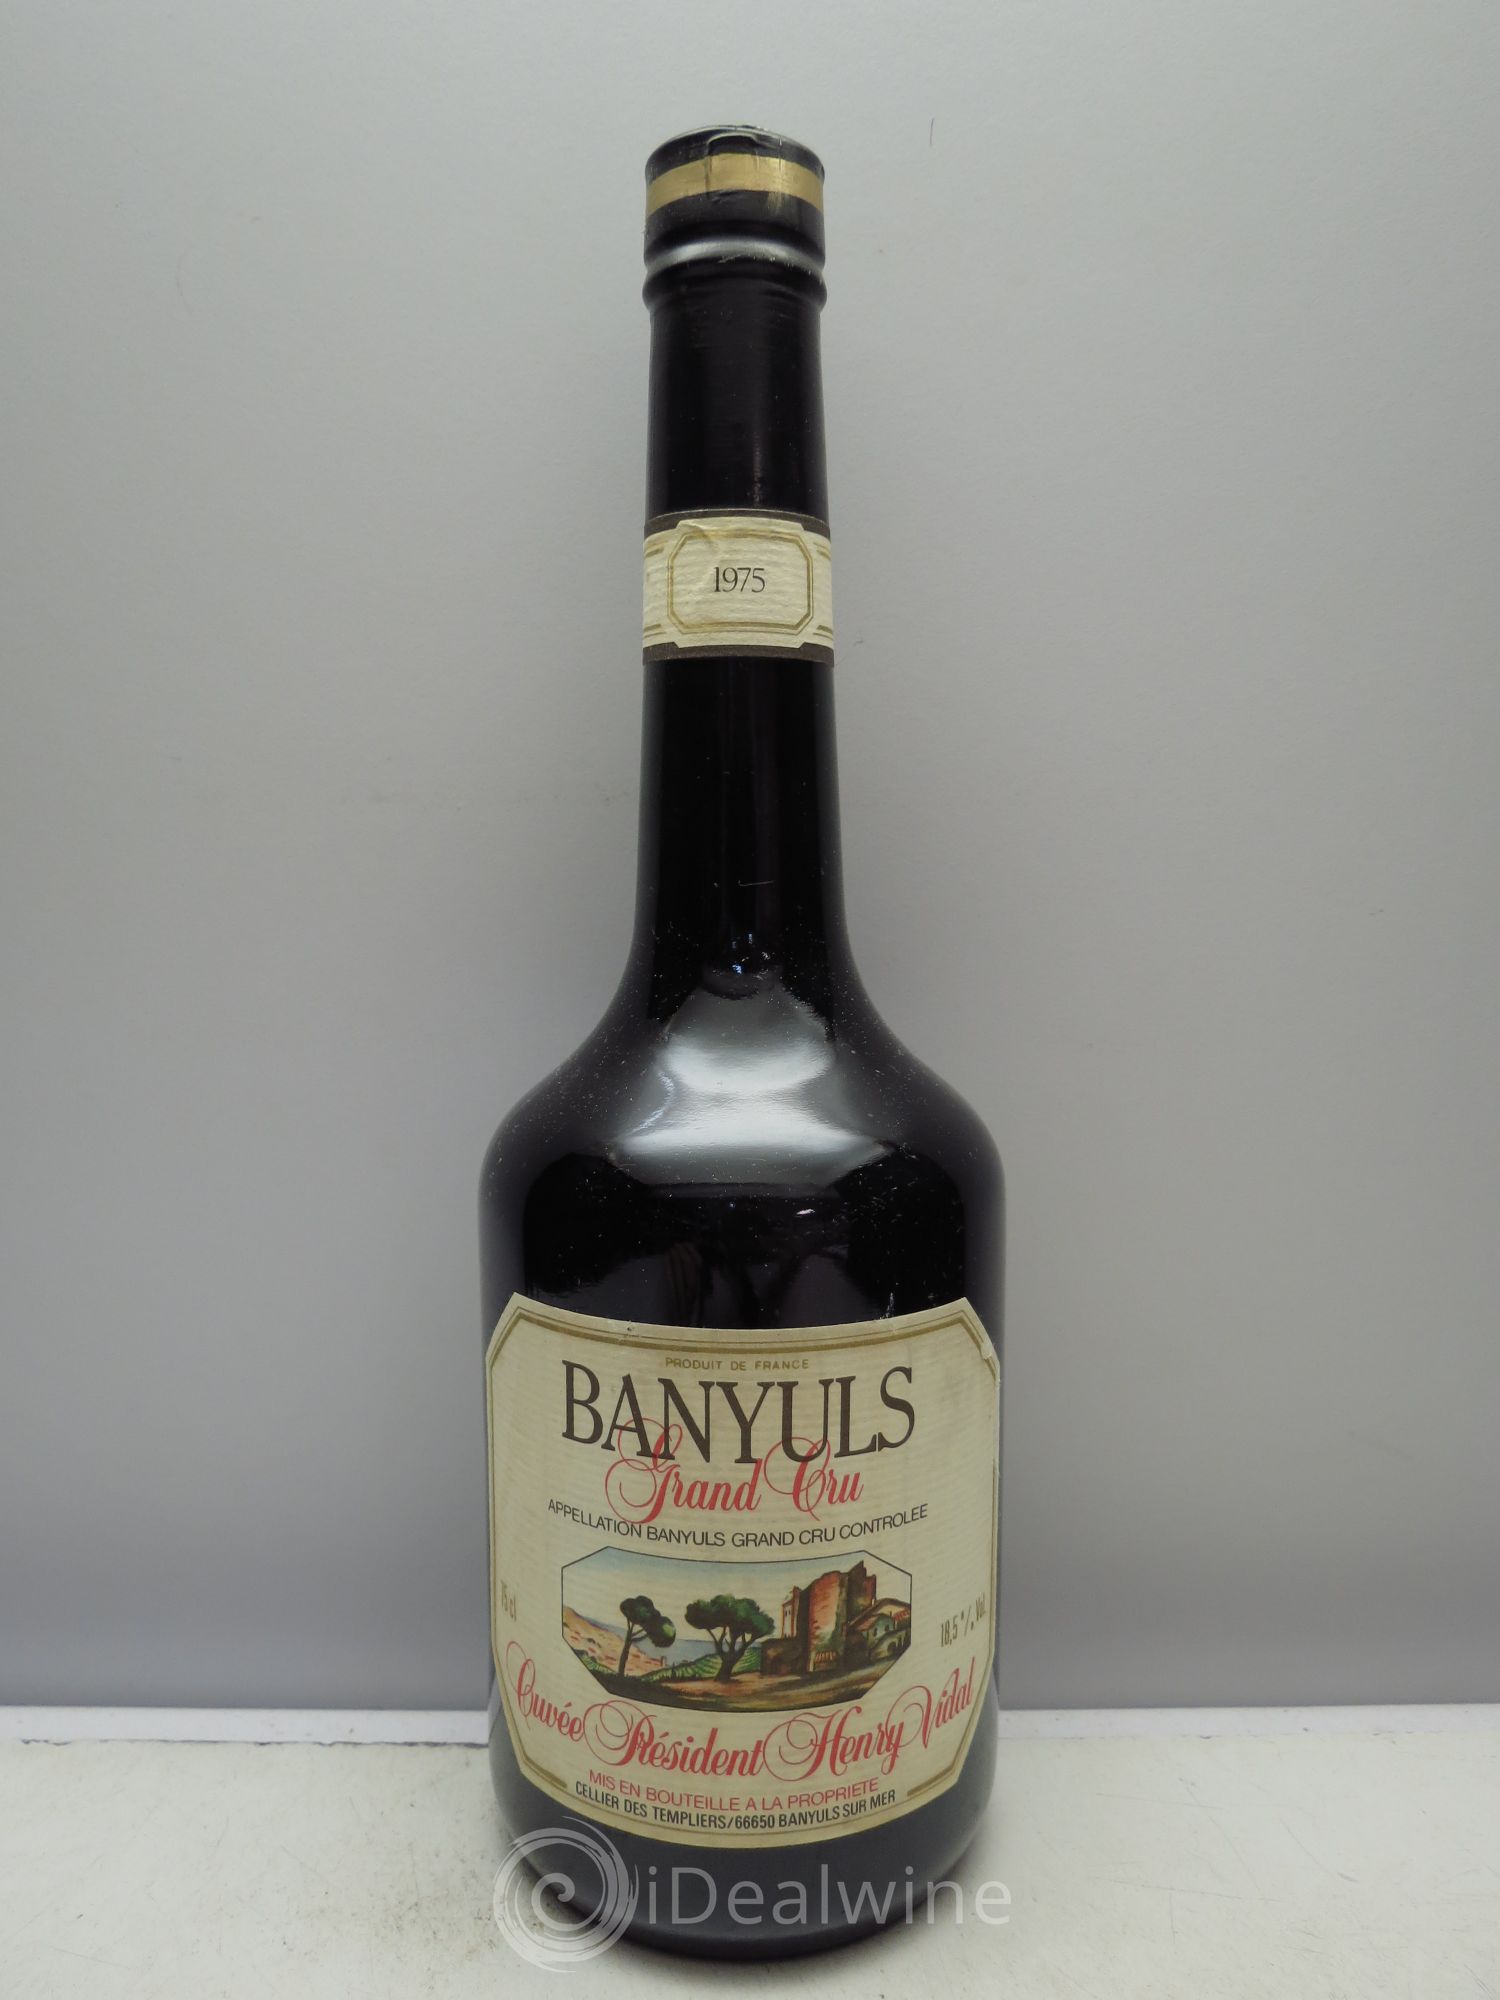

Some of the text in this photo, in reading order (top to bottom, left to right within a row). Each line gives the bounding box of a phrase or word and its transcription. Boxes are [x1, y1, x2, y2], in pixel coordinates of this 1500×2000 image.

[713, 566, 766, 593] 1975
[665, 1356, 810, 1371] PRODUIT DE FRANCE
[561, 1359, 915, 1464] BANYULS
[605, 1417, 865, 1524] Grand Cru
[547, 1499, 929, 1548] APPELLATION BANYULS GRAND CRU CONTROLEE
[506, 1640, 585, 1743] Cuvée
[763, 1705, 905, 1782] Henry
[885, 1655, 976, 1749] Vidal
[575, 1780, 620, 1810] CELLIER
[623, 1798, 648, 1818] DES
[778, 1806, 841, 1829] BANYULS
[842, 1799, 868, 1818] SUR
[869, 1789, 897, 1810] MER
[589, 1768, 880, 1812] MIS EN BOUTEILLE A LA PROPRIETE
